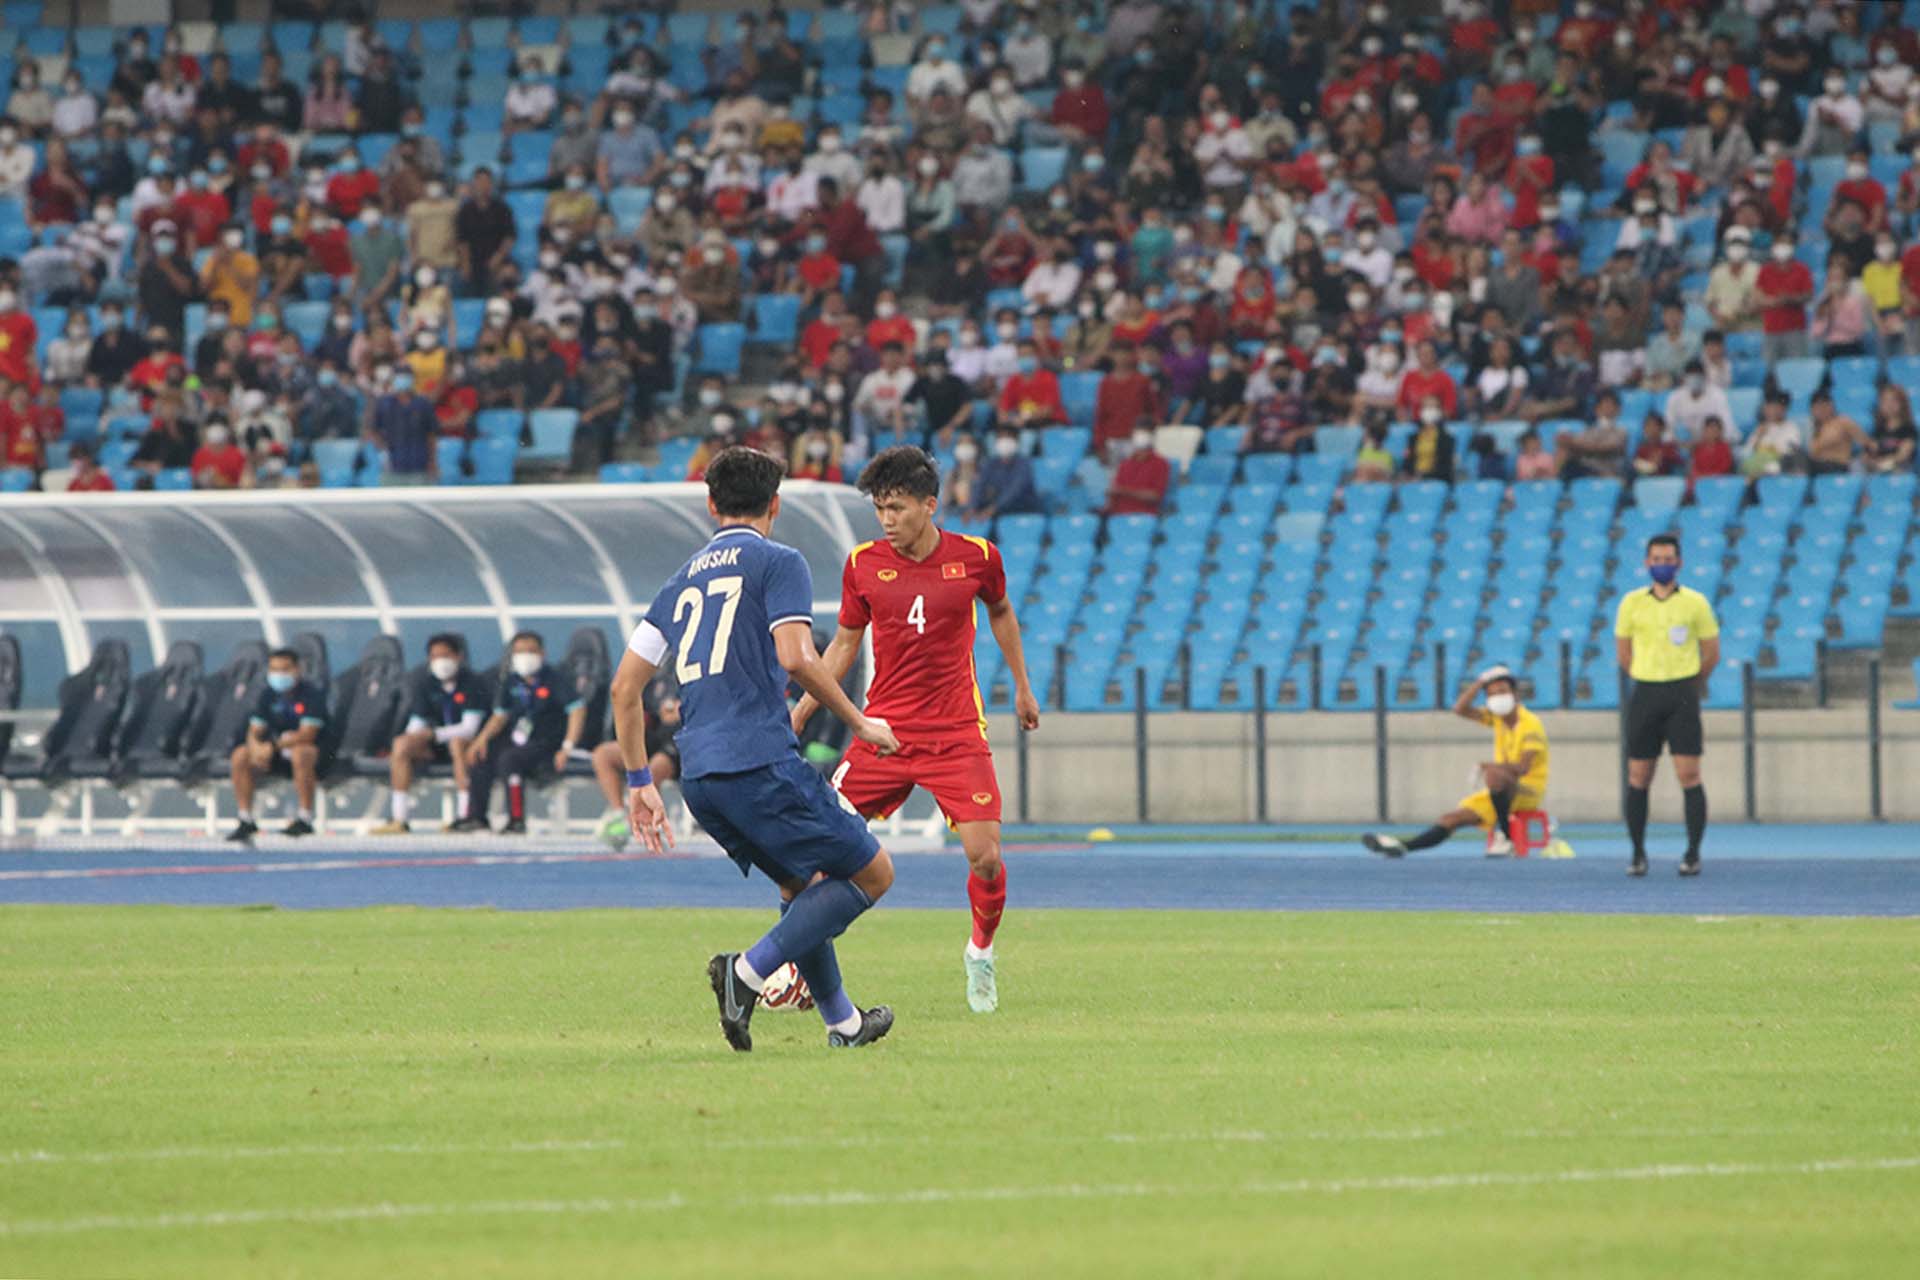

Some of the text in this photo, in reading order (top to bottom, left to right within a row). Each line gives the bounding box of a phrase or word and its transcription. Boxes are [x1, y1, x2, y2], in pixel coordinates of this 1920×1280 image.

[673, 576, 743, 685] 27
[907, 595, 926, 634] 4
[831, 760, 851, 791] 4
